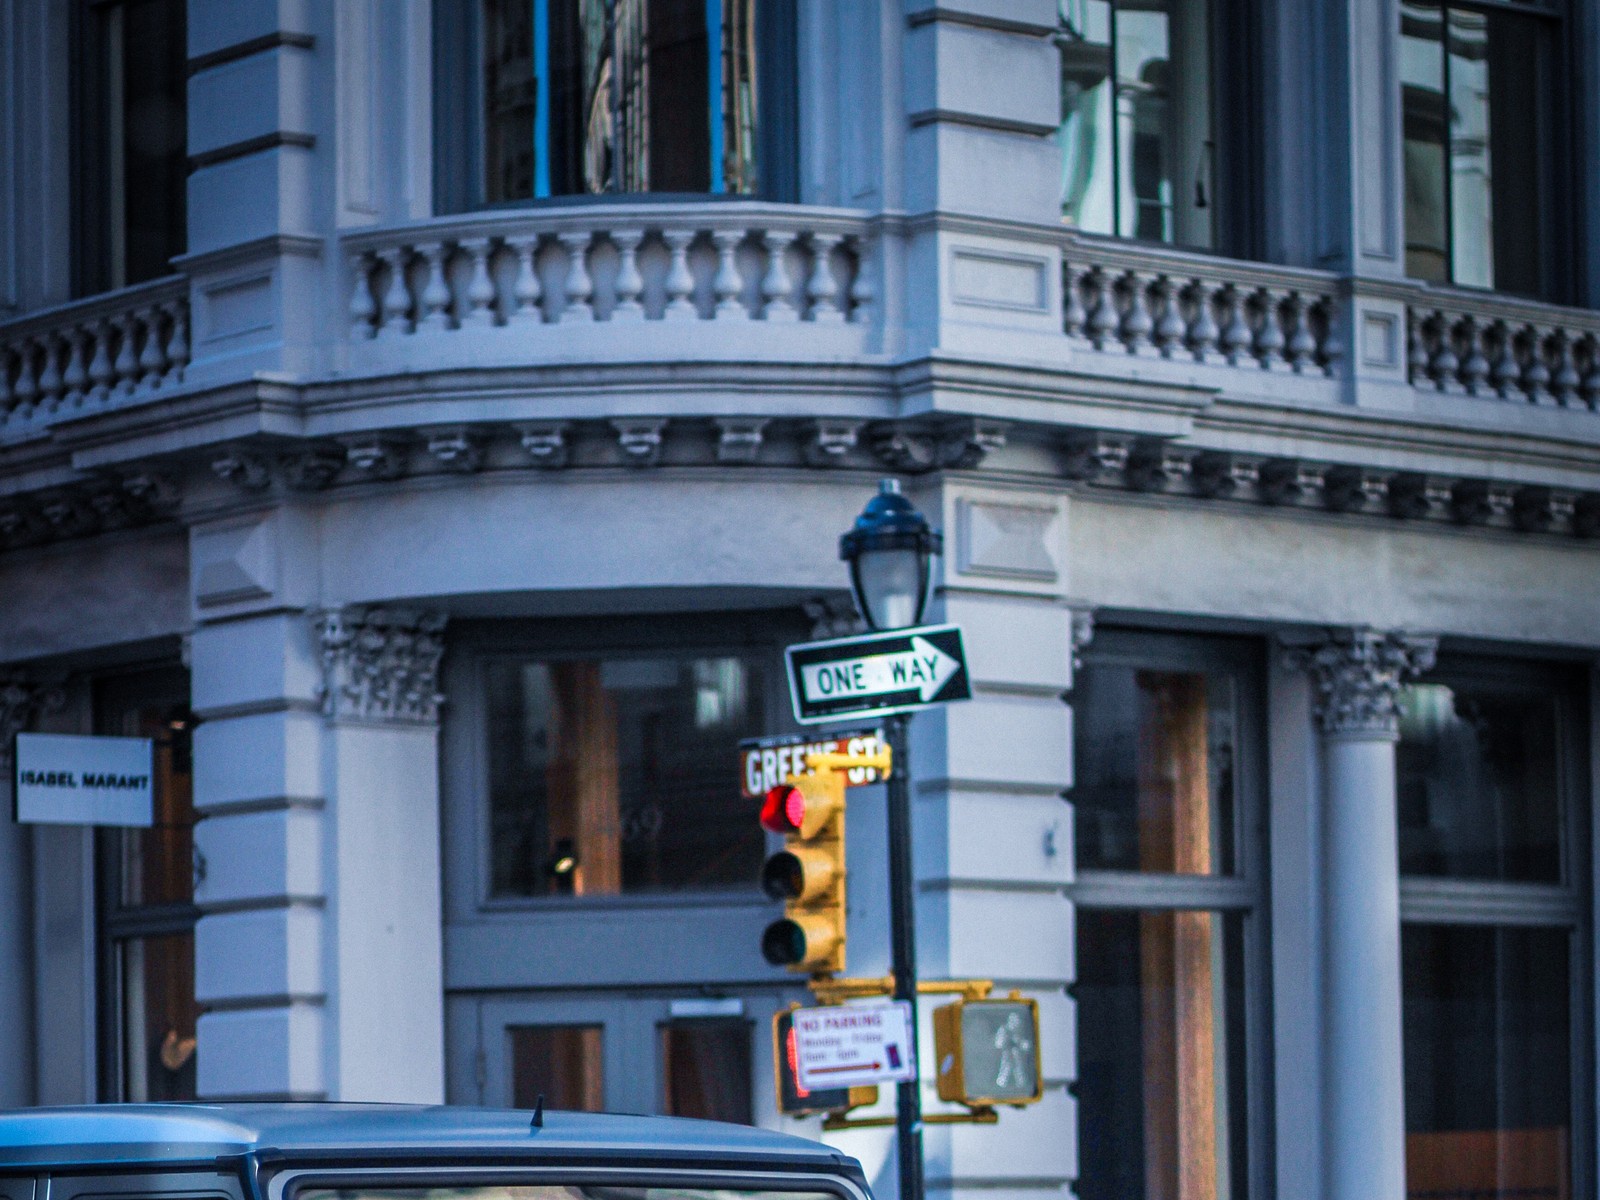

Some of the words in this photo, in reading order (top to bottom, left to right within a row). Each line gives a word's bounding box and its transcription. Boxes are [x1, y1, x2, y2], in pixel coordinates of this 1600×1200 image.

[818, 663, 866, 695] ONE
[889, 654, 939, 684] WAY
[847, 736, 878, 784] ST
[20, 769, 77, 788] ISABEL
[82, 771, 148, 790] MARANT
[802, 1020, 819, 1031] NO
[824, 1014, 881, 1029] PARKING
